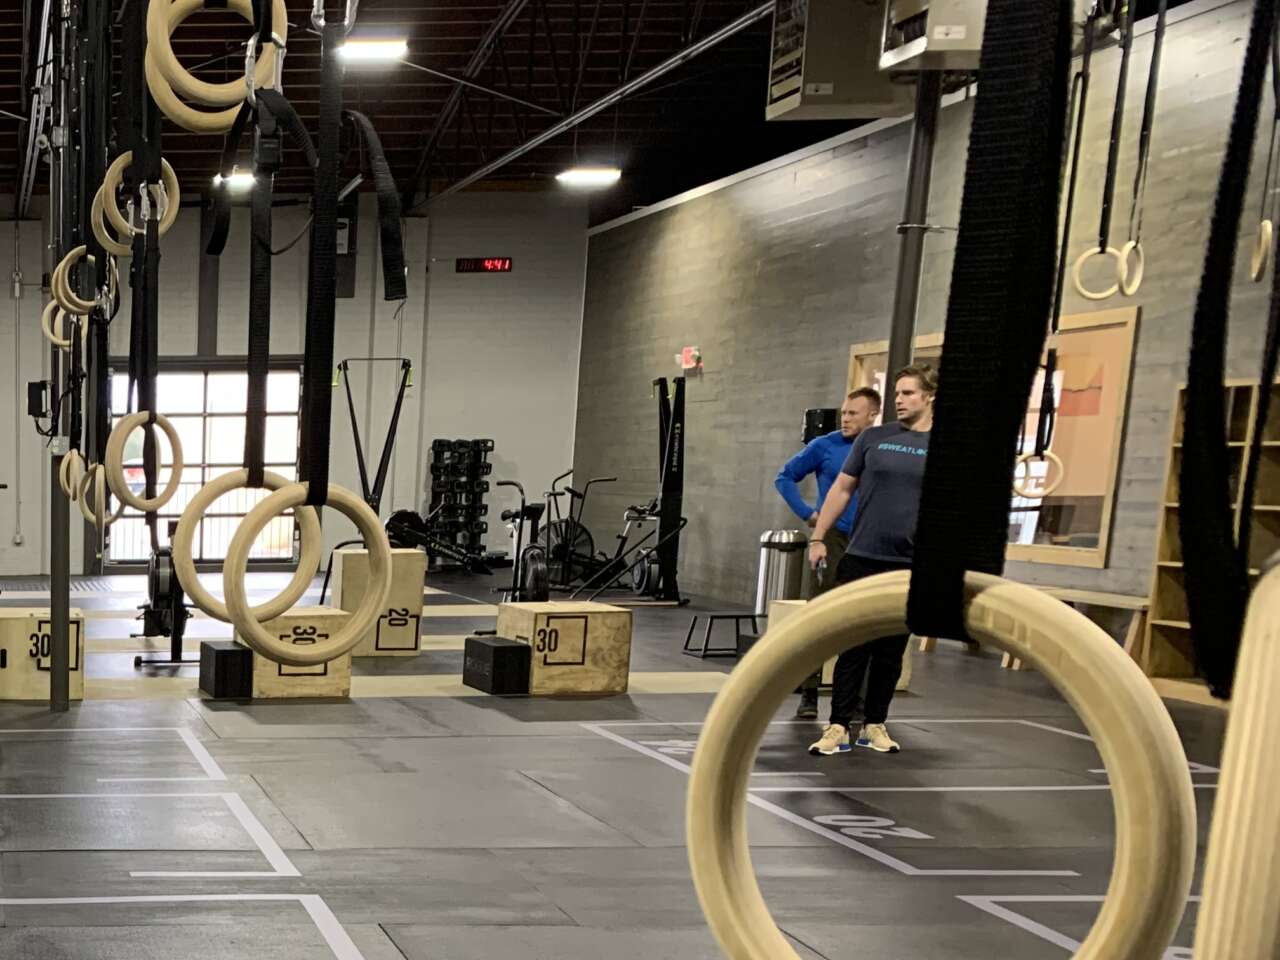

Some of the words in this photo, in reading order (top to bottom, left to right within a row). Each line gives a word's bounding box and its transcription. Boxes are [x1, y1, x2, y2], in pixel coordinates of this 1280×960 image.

[388, 608, 410, 627] 20
[29, 633, 51, 658] 30
[536, 628, 559, 653] 30
[812, 814, 936, 840] 20
